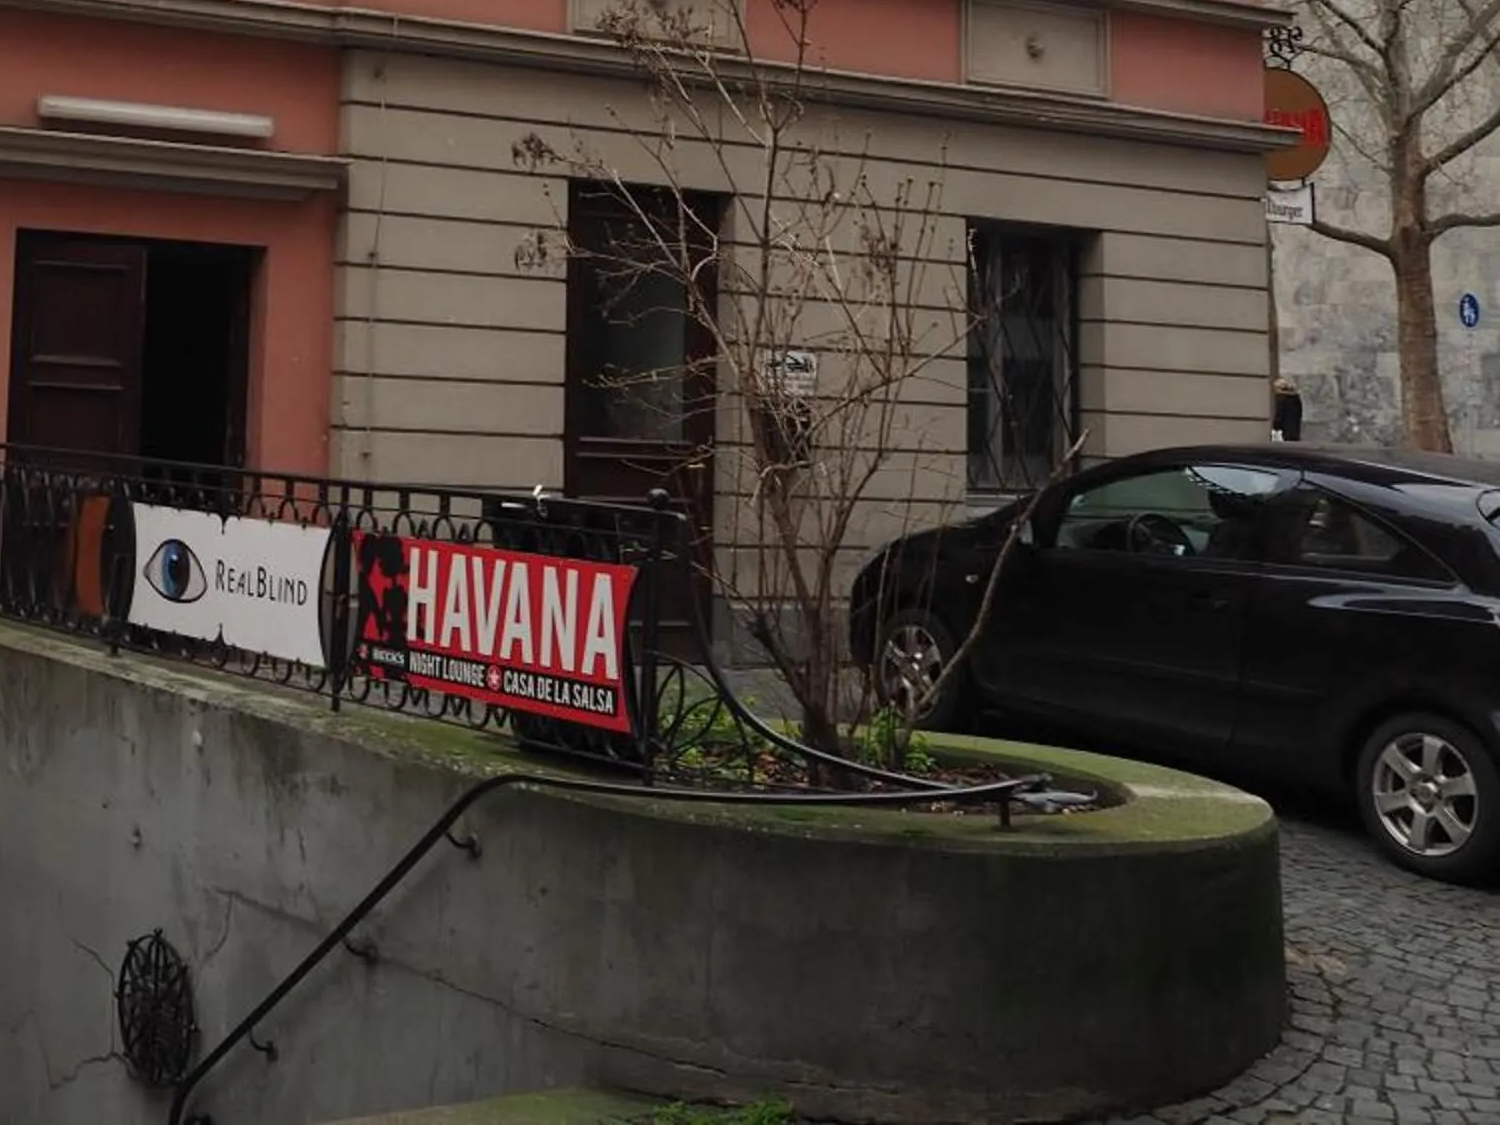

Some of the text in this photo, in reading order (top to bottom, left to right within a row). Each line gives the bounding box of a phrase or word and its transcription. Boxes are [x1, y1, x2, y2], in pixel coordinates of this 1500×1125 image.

[406, 546, 619, 681] HAVANA
[409, 651, 615, 715] NIGHT LOUNGE CASA DE LA SALSA
